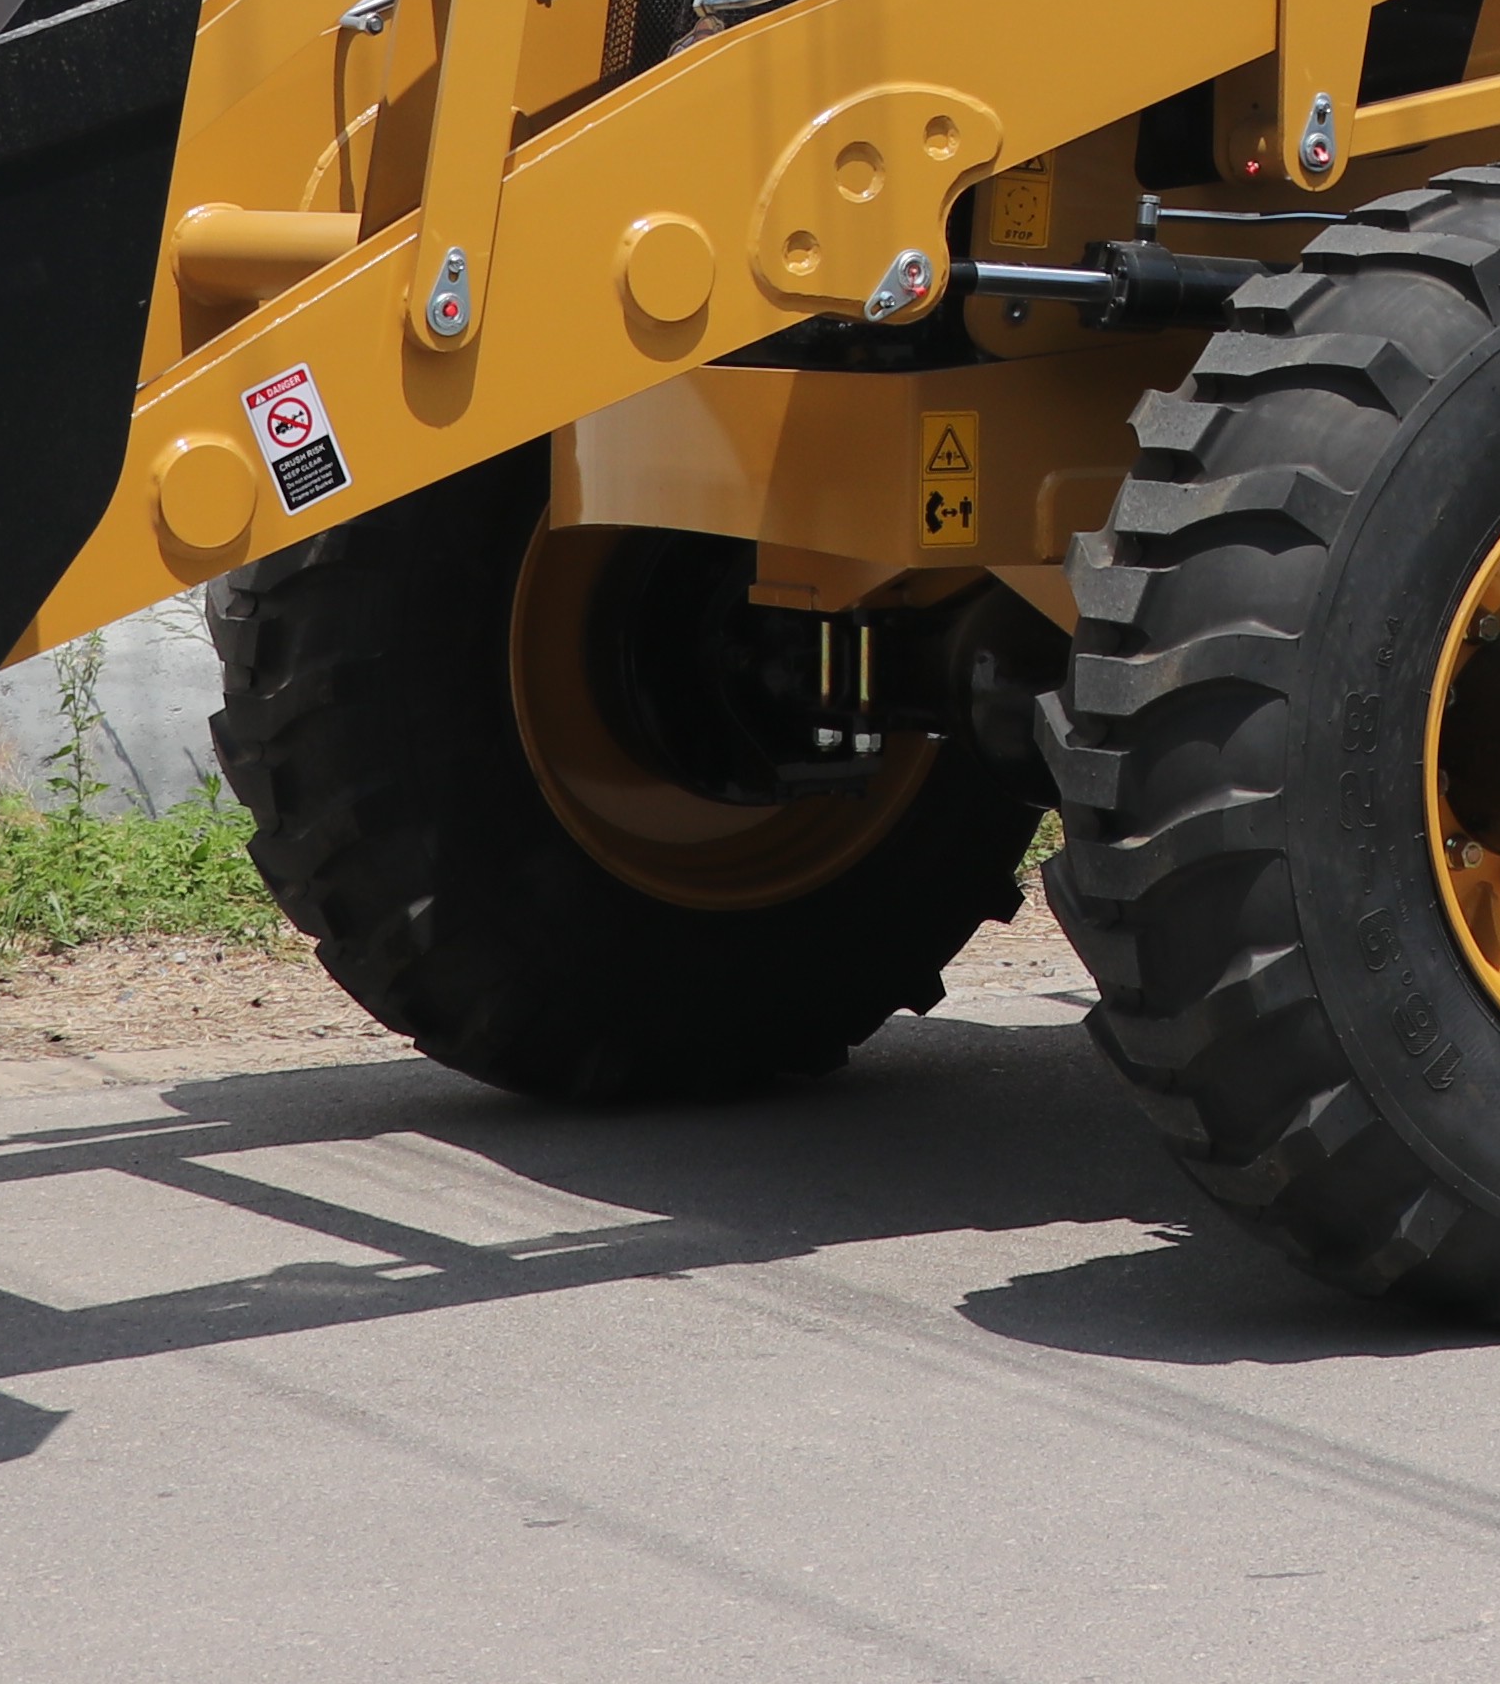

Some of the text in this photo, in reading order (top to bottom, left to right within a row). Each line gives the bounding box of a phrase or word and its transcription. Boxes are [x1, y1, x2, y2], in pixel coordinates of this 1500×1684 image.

[1004, 228, 1033, 241] STOP
[266, 374, 301, 398] DANGER
[279, 443, 326, 472] CRUSH RISK
[283, 457, 323, 481] KEEP CLEAR
[314, 477, 334, 492] Bucket
[1338, 690, 1463, 1089] 16.9-28
